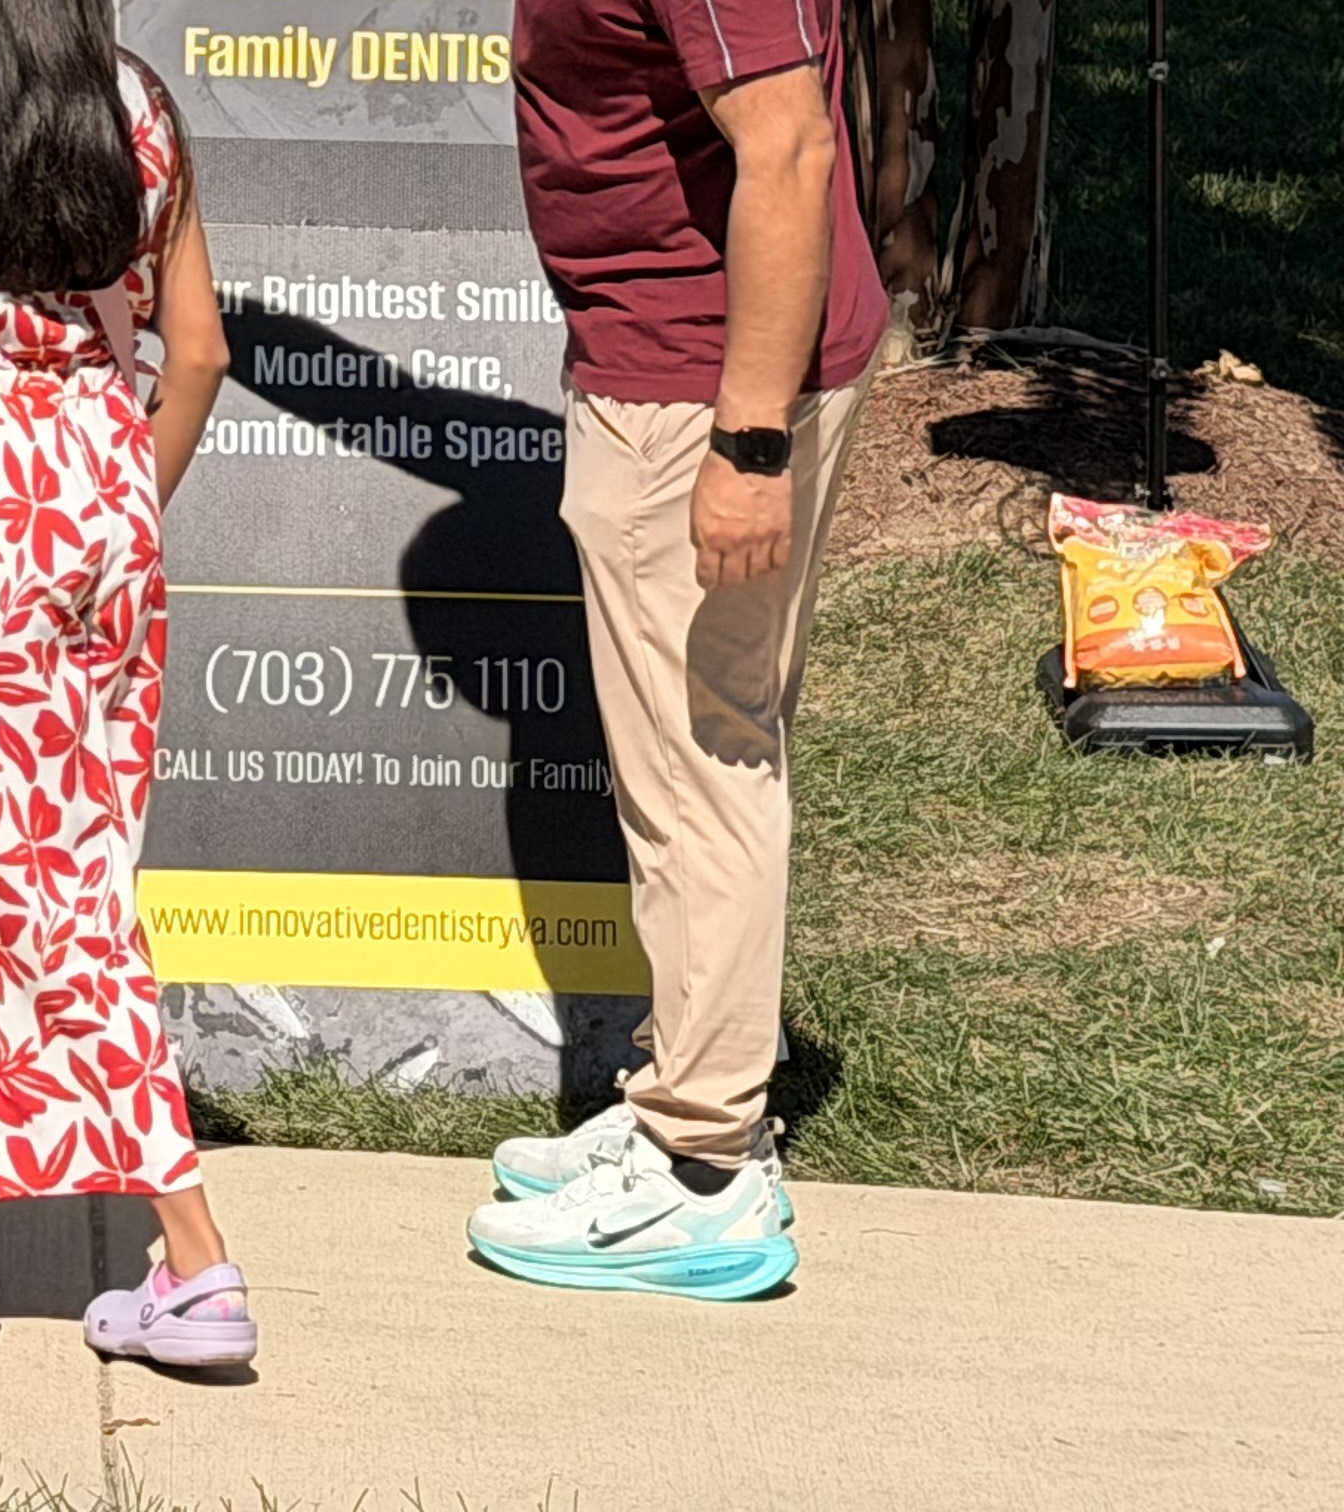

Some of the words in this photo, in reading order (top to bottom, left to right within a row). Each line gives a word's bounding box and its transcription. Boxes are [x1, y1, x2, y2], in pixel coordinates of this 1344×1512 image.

[184, 25, 338, 89] Family
[350, 29, 511, 85] DENTIS
[262, 274, 446, 324] Brightest
[253, 344, 399, 389] Modern
[411, 348, 513, 401] Care,
[444, 418, 563, 468] Space
[205, 643, 353, 716] (703)
[370, 653, 455, 710] 775
[473, 656, 566, 713] 1110
[152, 747, 219, 782] CALL
[227, 750, 265, 782] US
[273, 751, 364, 785] TODAY!
[371, 753, 401, 786] To
[408, 754, 461, 788] Join
[471, 755, 522, 789] Our
[529, 757, 613, 798] Family
[149, 901, 619, 951] www.innovativedentistryva.com
